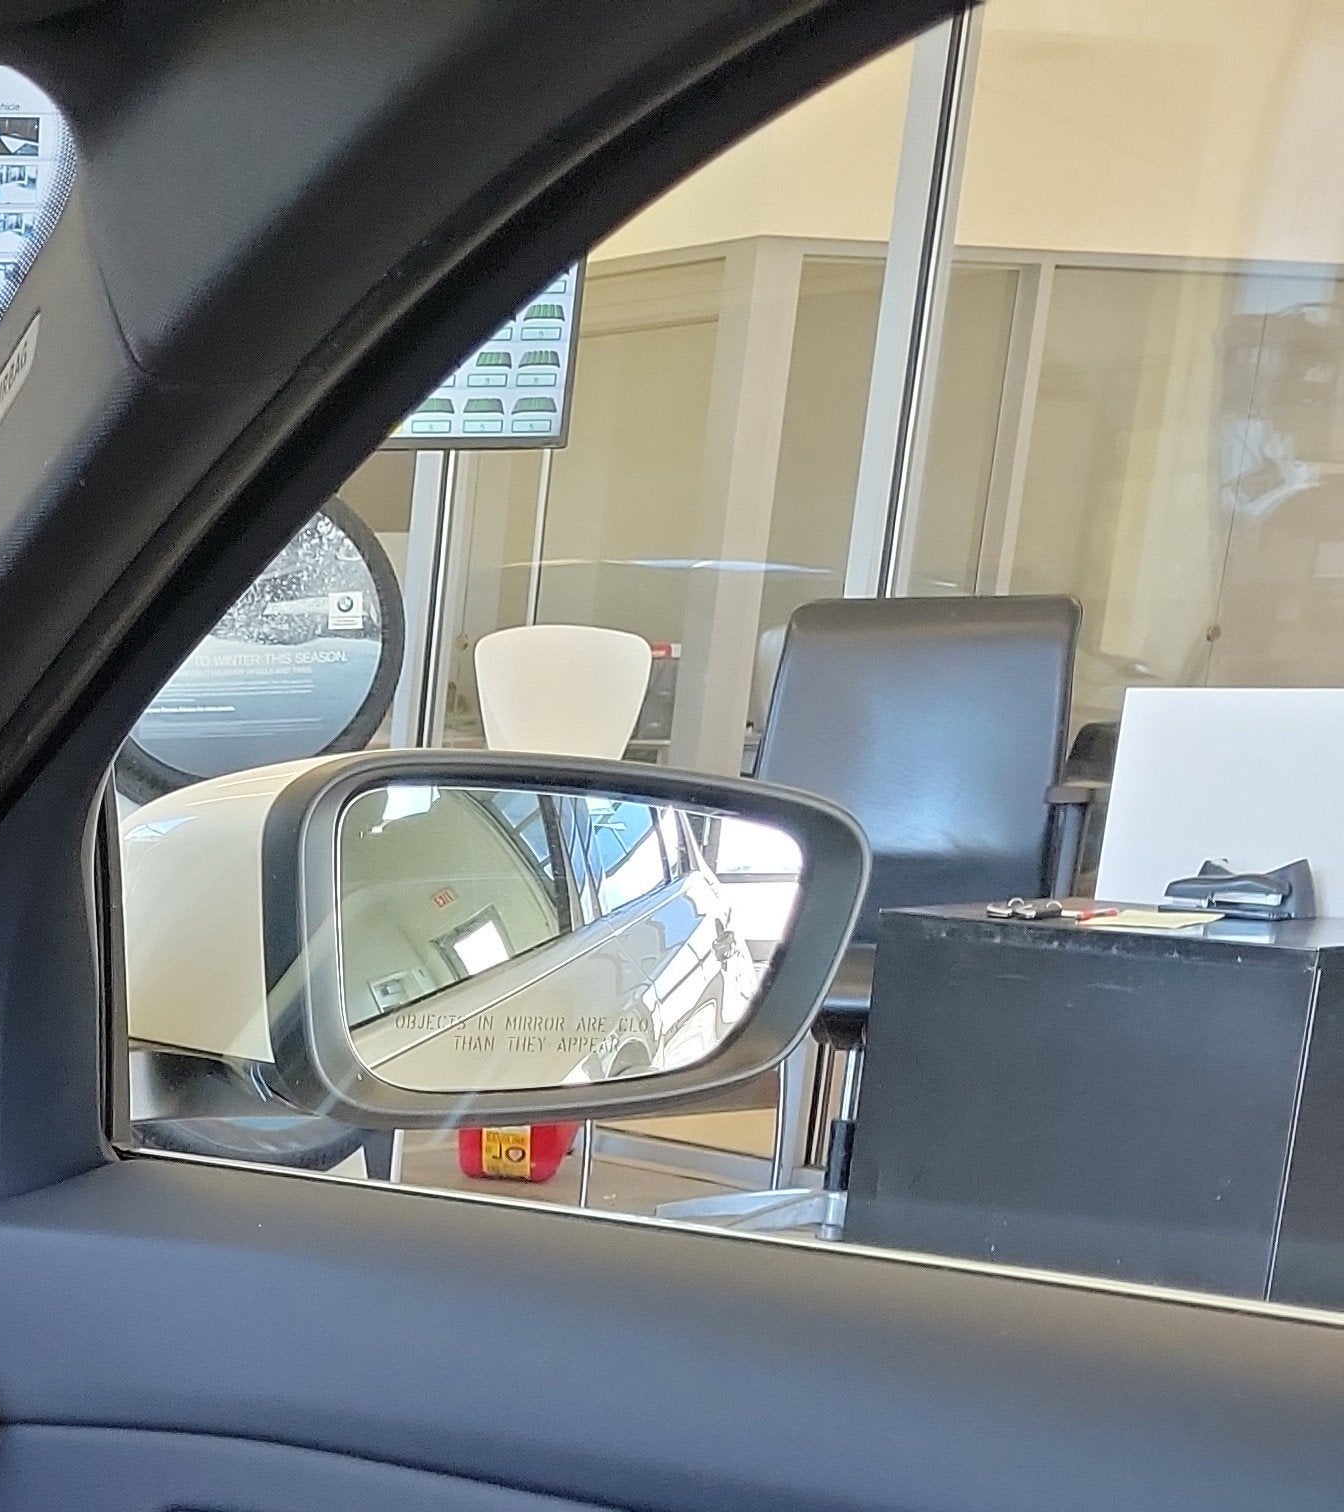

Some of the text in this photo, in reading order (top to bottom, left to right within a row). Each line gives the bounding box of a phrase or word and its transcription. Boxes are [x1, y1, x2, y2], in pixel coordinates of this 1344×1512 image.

[395, 1014, 467, 1031] OBJECTS
[477, 1015, 494, 1031] IN
[505, 1015, 566, 1032] MIRROR
[576, 1015, 607, 1032] ARE
[453, 1035, 620, 1053] THAN THEY APPEAR
